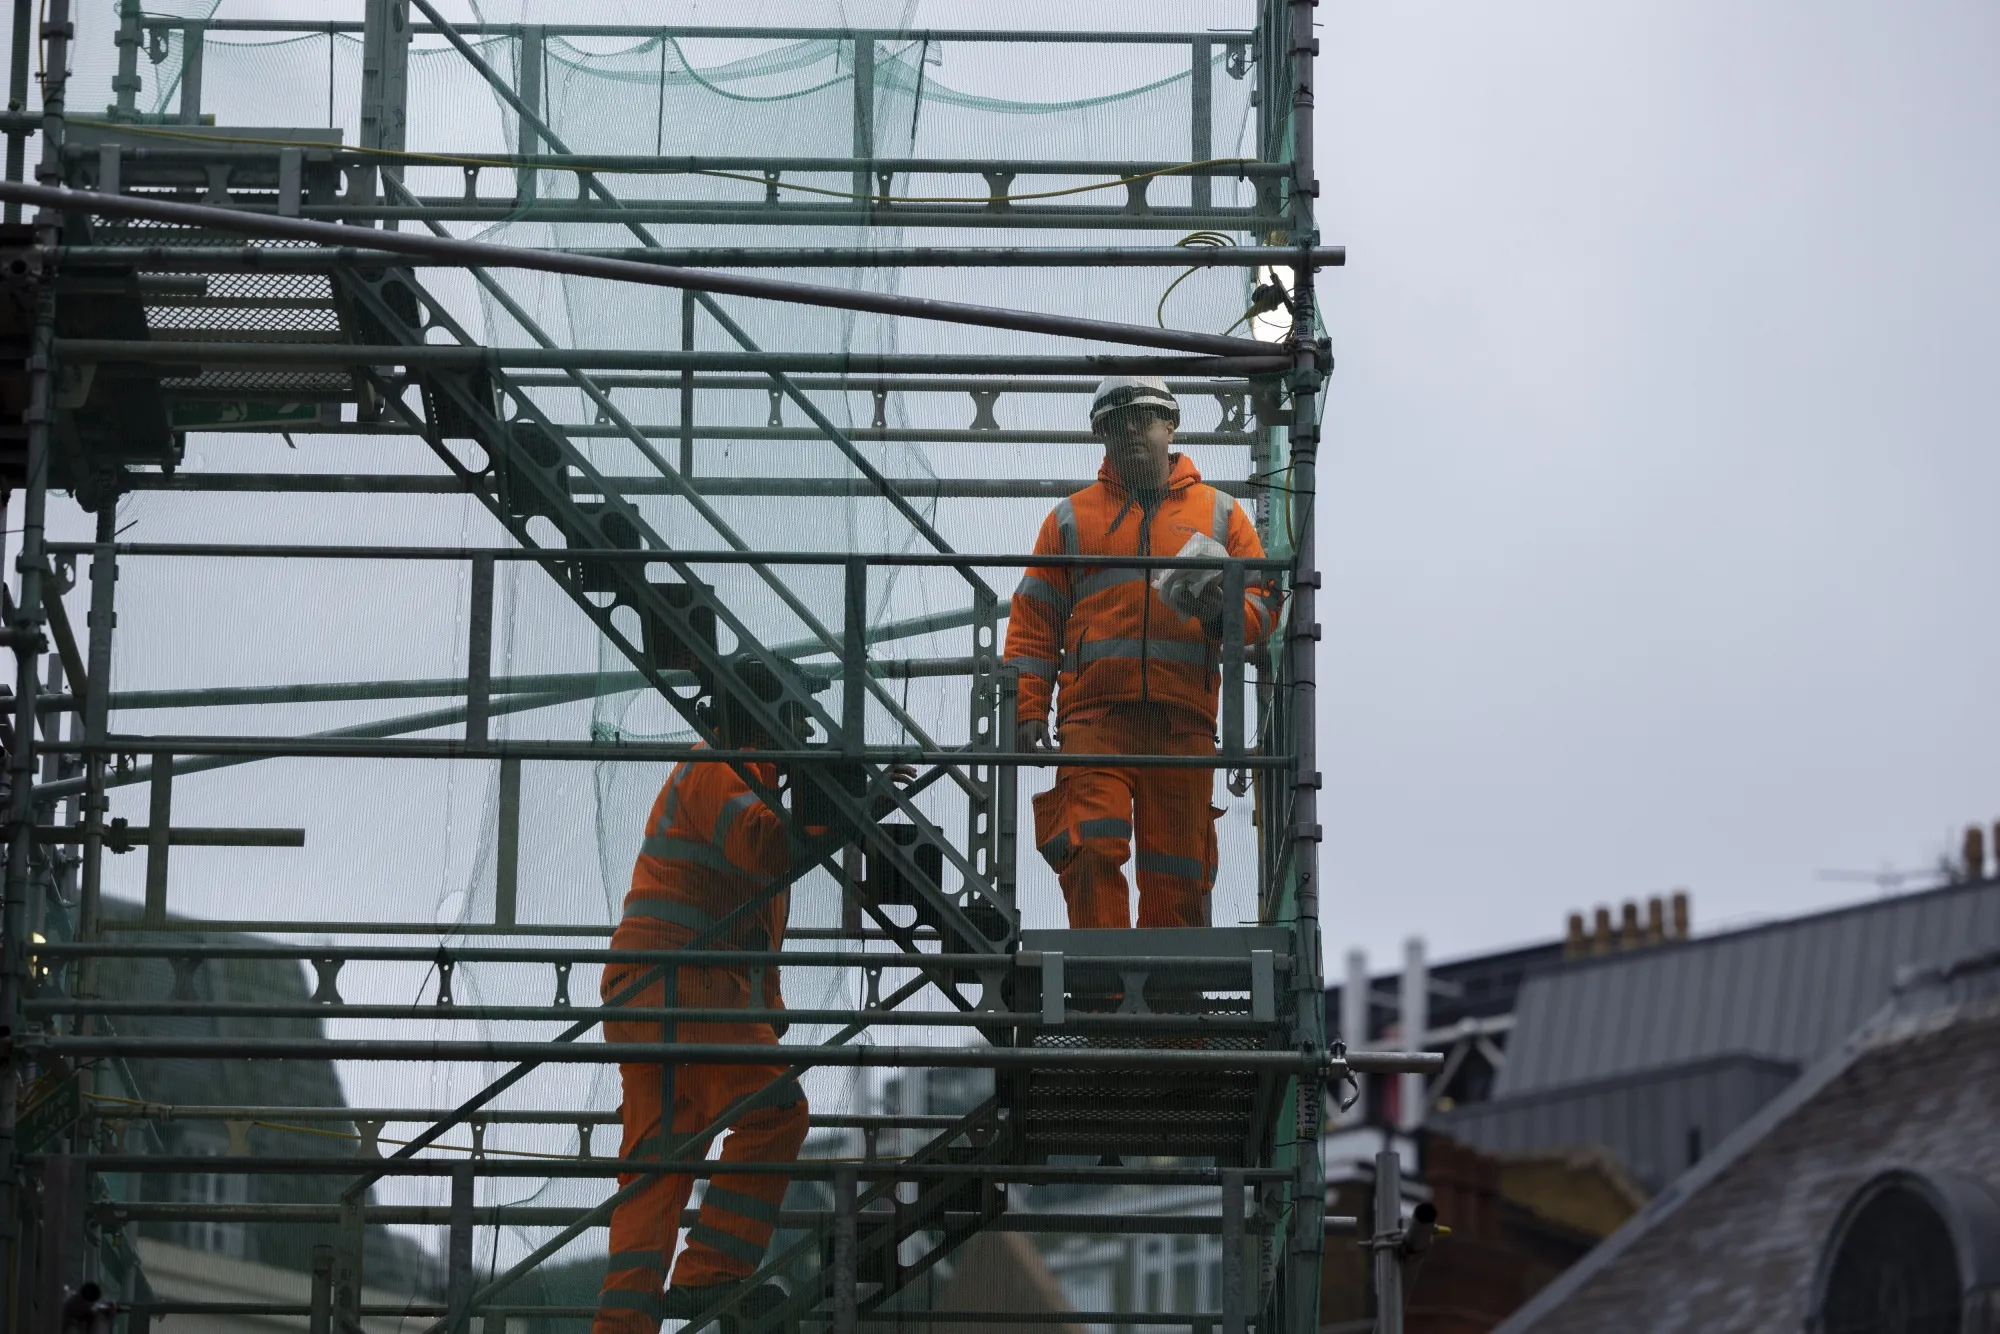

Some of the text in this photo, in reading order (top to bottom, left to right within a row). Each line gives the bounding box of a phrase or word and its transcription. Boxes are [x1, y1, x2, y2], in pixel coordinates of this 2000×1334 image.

[32, 1091, 70, 1128] Fire
[1304, 1086, 1316, 1125] HAKI
[33, 1106, 71, 1145] exit
